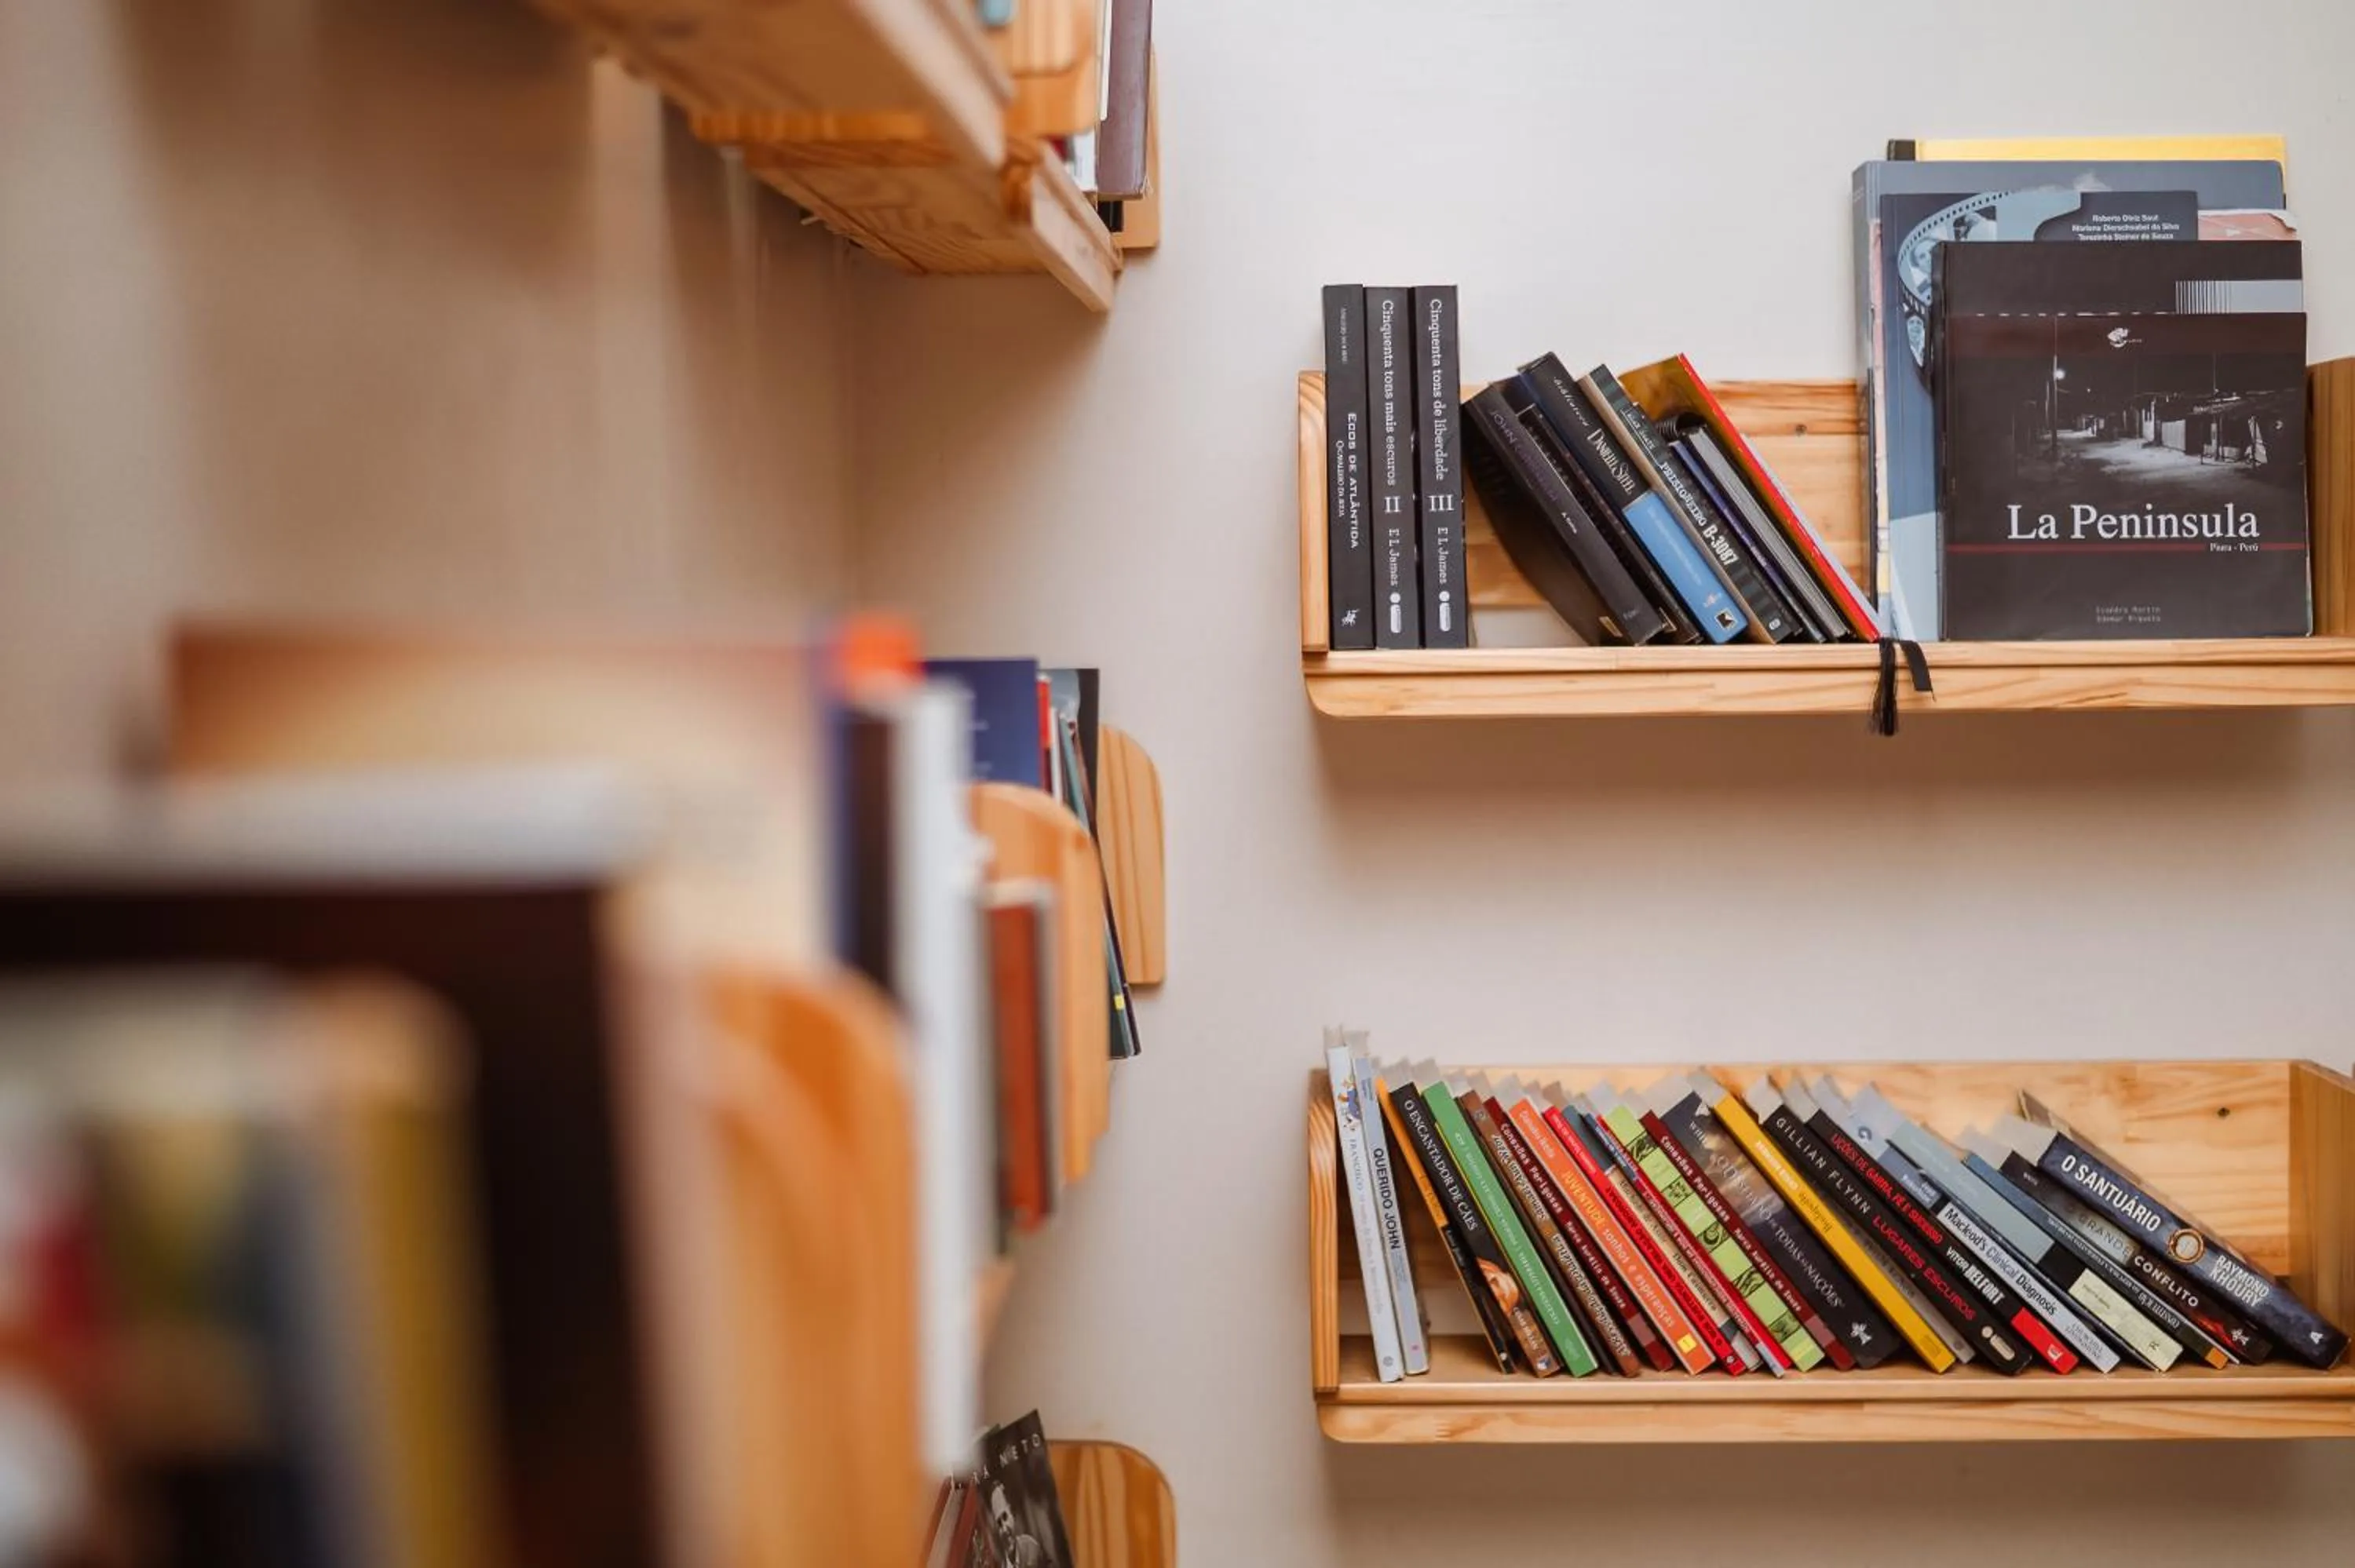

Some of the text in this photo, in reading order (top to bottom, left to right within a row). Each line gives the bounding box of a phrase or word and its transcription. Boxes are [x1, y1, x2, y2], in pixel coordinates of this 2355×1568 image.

[1378, 300, 1397, 485] Cinquenta tons mais escuros
[1427, 298, 1448, 480] Cinquenta tons de liberdade
[1348, 454, 1358, 473] DE
[1349, 476, 1362, 548] ATLÂNTIDA
[1385, 496, 1400, 512] II
[1429, 494, 1453, 512] III
[2006, 502, 2260, 540] La Peninsula
[1388, 527, 1399, 537] E
[1437, 526, 1448, 535] E
[1700, 521, 1740, 567] B-3087
[1388, 549, 1400, 586] James
[1437, 547, 1449, 584] James
[1402, 1097, 1416, 1111] O
[1407, 1108, 1455, 1187] ENCANTADOR
[1499, 1121, 1532, 1165] Conexões
[1525, 1164, 1565, 1216] Perigosas
[1372, 1147, 1394, 1209] QUERIDO
[1383, 1210, 1401, 1249] JOHN
[1446, 1183, 1463, 1204] DE
[2057, 1151, 2166, 1234] O SANTUÁRIO
[1455, 1198, 1481, 1233] CÃES
[1773, 1115, 1827, 1169] GILLIAN
[1826, 1169, 1873, 1215] FLYNN
[1869, 1214, 1927, 1271] LUGARES
[1920, 1265, 1977, 1322] ESCUROS
[1601, 1227, 1630, 1264] sonhos
[1772, 1225, 1805, 1260] TODAS
[1942, 1206, 1991, 1253] Macleod's
[1984, 1244, 2020, 1278] Clinical
[2013, 1271, 2060, 1317] Diagnosis
[1943, 1245, 1970, 1272] VITOR
[1962, 1263, 2006, 1306] BELFORT
[2131, 1253, 2201, 1309] CONFLITO
[2207, 1264, 2263, 1311] KHOURY
[2213, 1253, 2271, 1300] RAYMOND
[999, 1433, 1040, 1468] NETO
